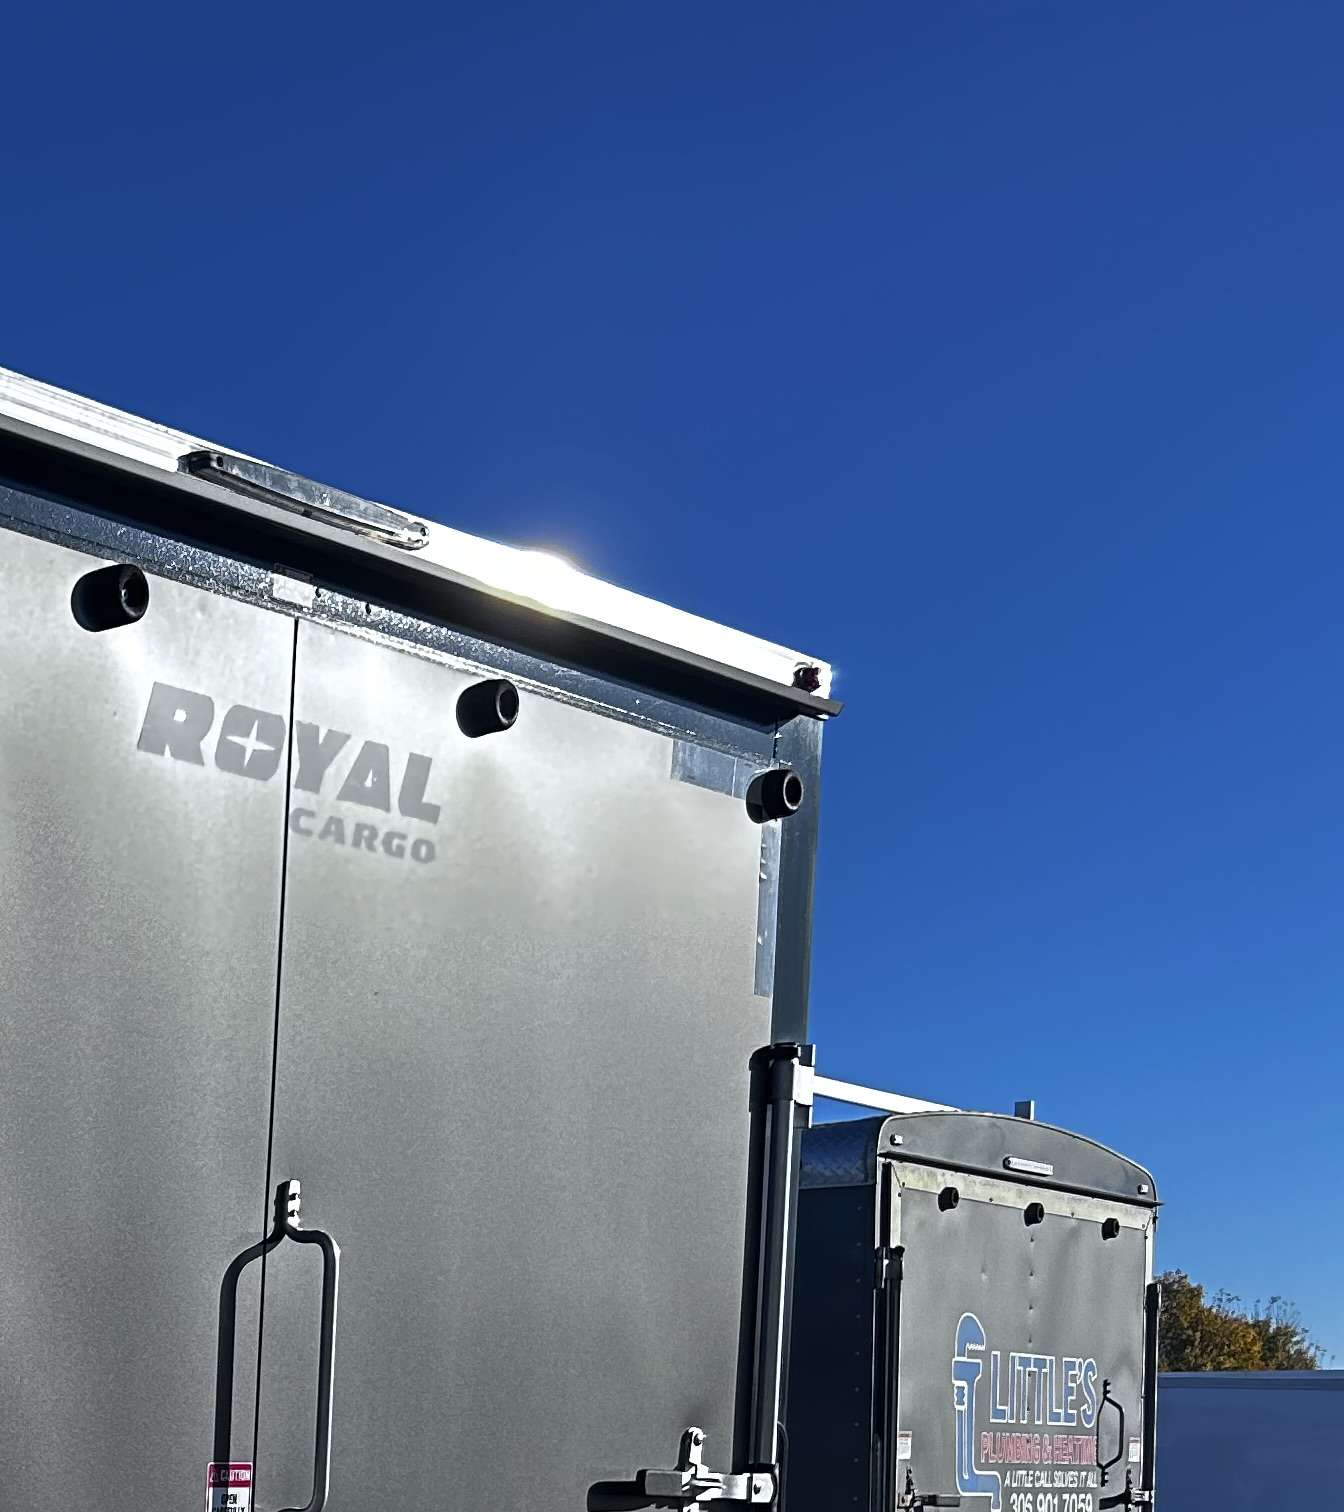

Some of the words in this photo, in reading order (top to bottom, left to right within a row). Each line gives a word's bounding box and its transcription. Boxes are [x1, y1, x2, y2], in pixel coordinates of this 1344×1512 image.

[137, 681, 441, 825] ROYAL
[289, 807, 437, 864] CARGO
[989, 1350, 1098, 1428] LITTLE'S
[981, 1431, 1041, 1464] PLUMBING
[1042, 1433, 1052, 1465] &
[221, 1493, 238, 1505] OPEN
[1004, 1470, 1012, 1488] A
[1012, 1470, 1034, 1488] LITTLE
[1034, 1470, 1052, 1488] CALL
[1053, 1470, 1079, 1488] SOLVES
[1079, 1471, 1087, 1488] IT
[1086, 1471, 1098, 1488] ALL
